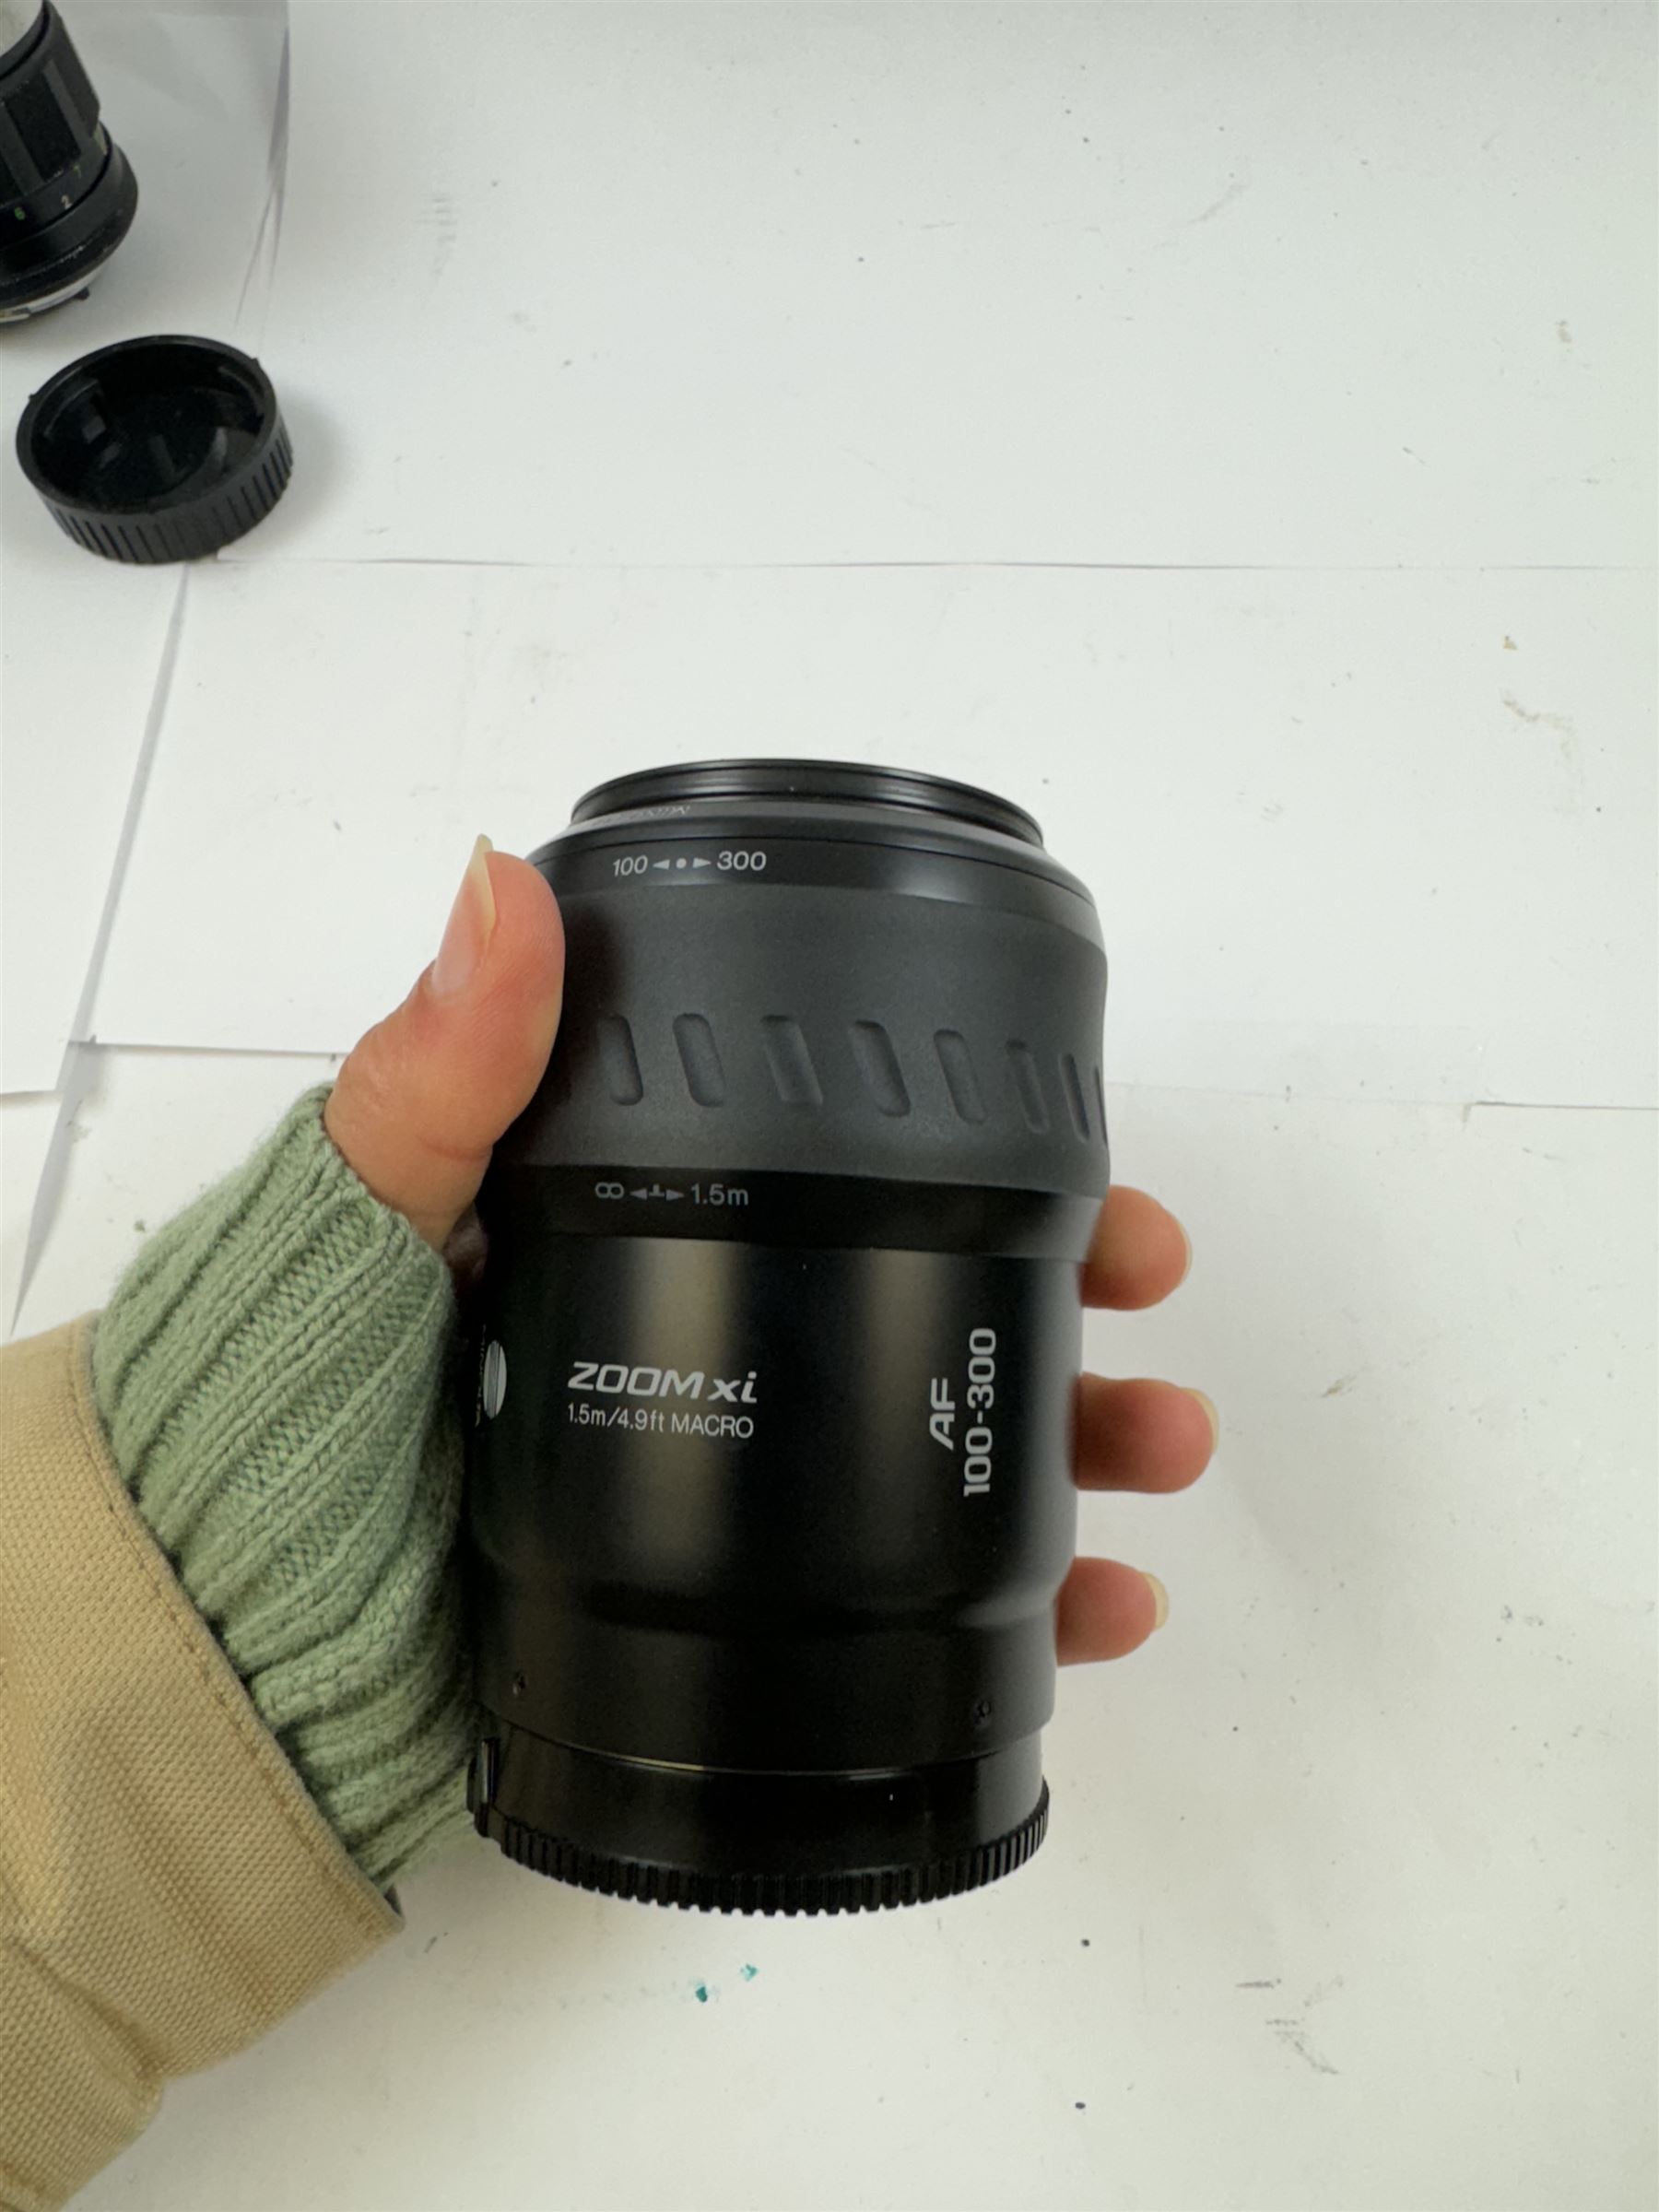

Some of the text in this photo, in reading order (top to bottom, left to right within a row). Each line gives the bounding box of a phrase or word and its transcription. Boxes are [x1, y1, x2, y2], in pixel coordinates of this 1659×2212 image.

[61, 194, 74, 210] 2
[612, 851, 768, 877] 100 300
[690, 1183, 749, 1206] 1.5m
[568, 1361, 758, 1404] ZOOM xi
[568, 1402, 755, 1439] 1.5m/4.9ft MACRO
[929, 1377, 956, 1452] AF
[963, 1327, 997, 1498] 100-300
